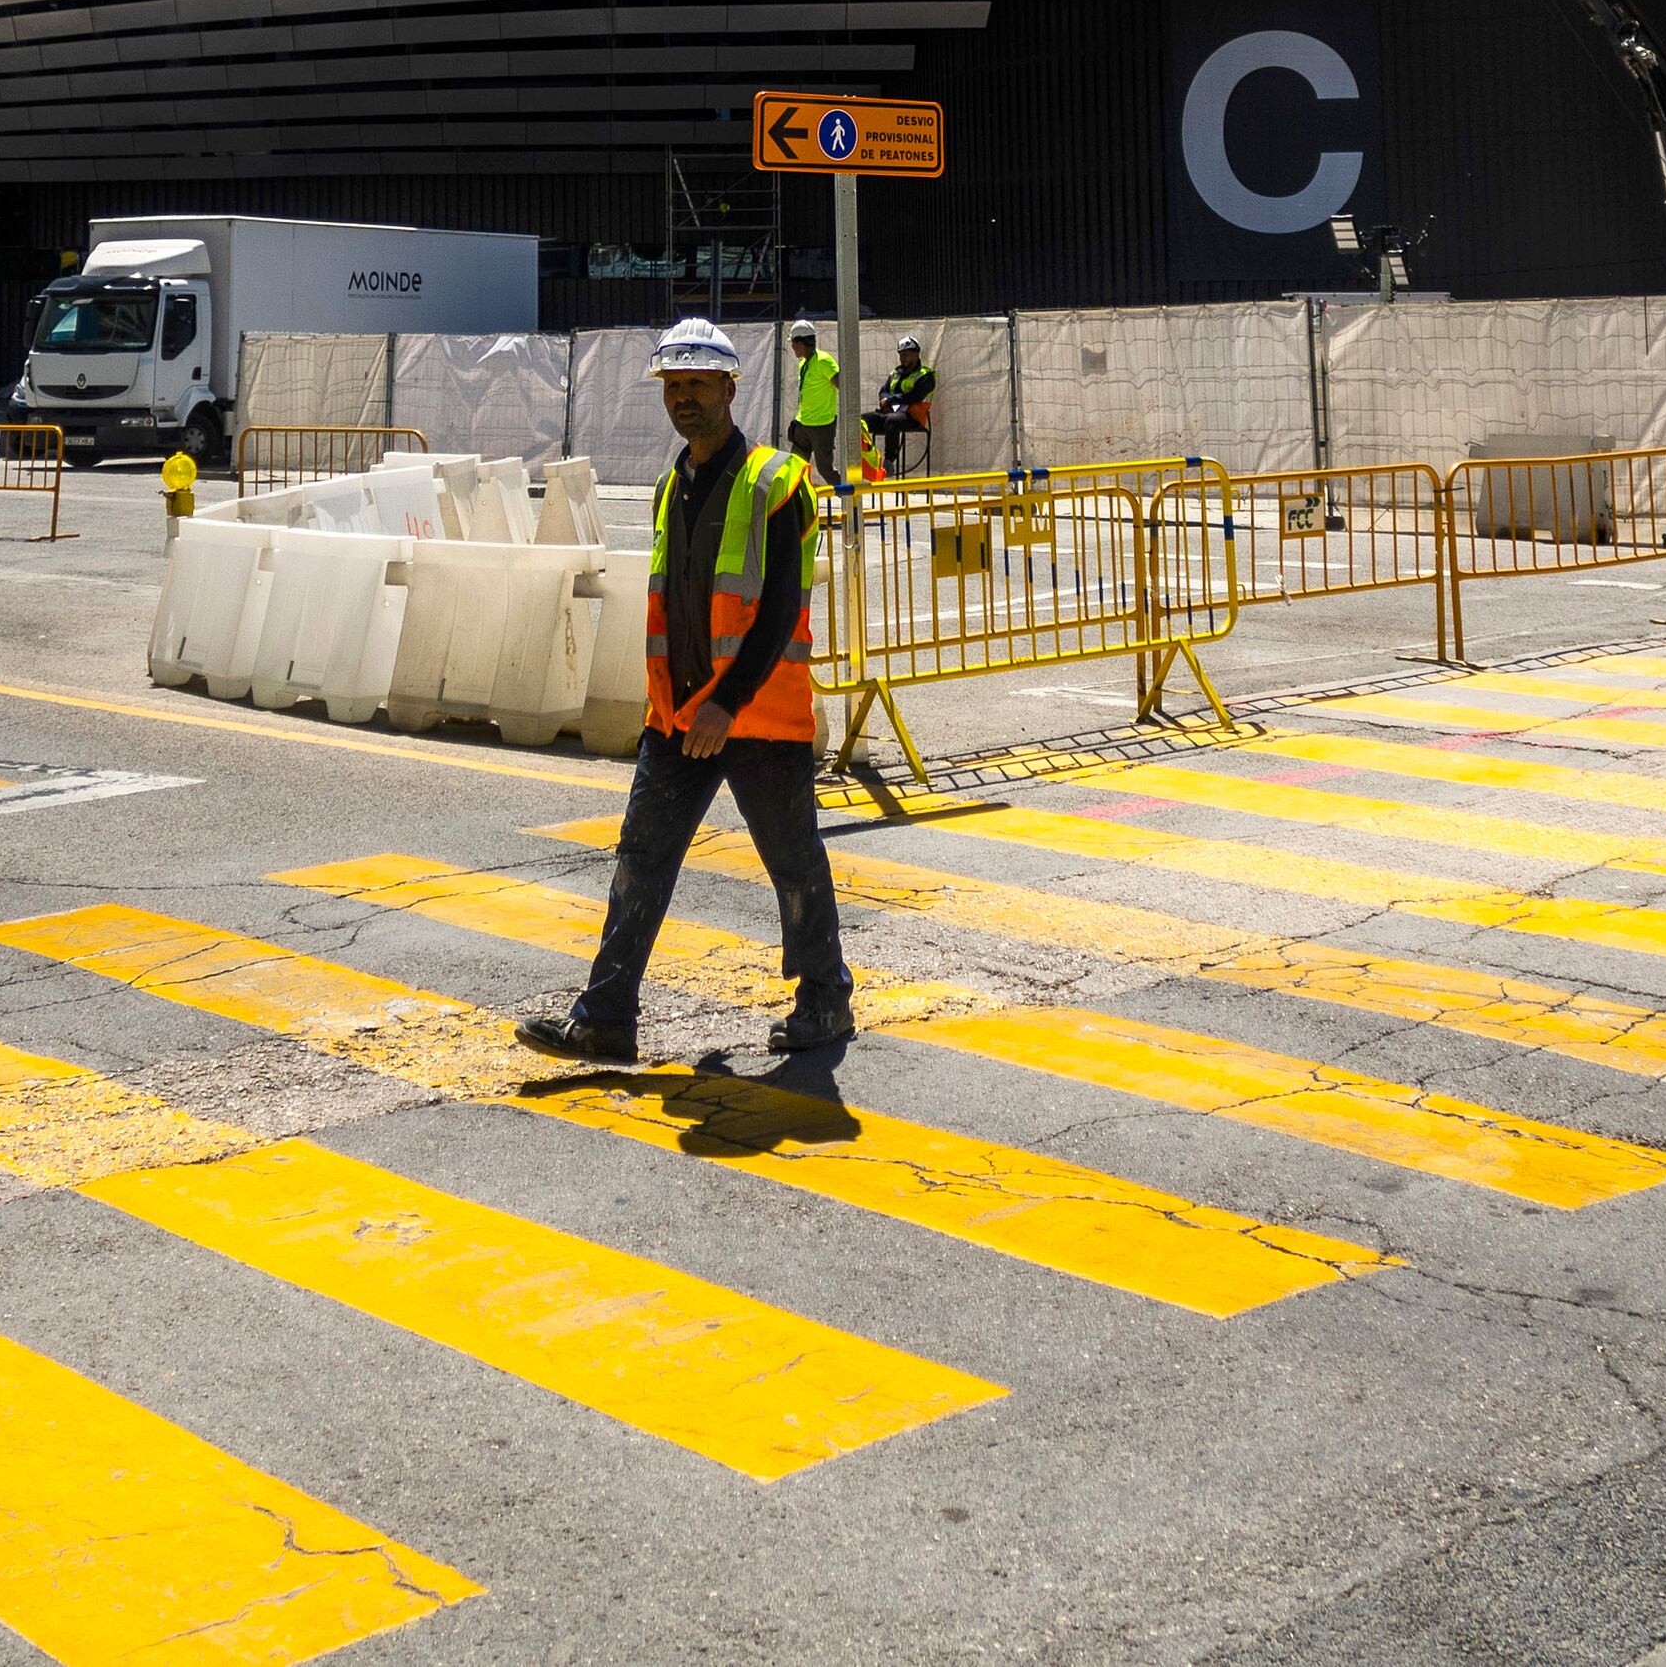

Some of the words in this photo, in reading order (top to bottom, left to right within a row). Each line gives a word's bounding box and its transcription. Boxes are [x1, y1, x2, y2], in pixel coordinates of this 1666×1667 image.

[896, 115, 935, 127] DESVIO
[865, 131, 935, 145] PROVISIONAL
[1182, 30, 1363, 234] C
[860, 148, 875, 160] DE
[880, 149, 935, 162] PEATONES
[1009, 501, 1051, 534] PM
[1288, 509, 1314, 531] FCC
